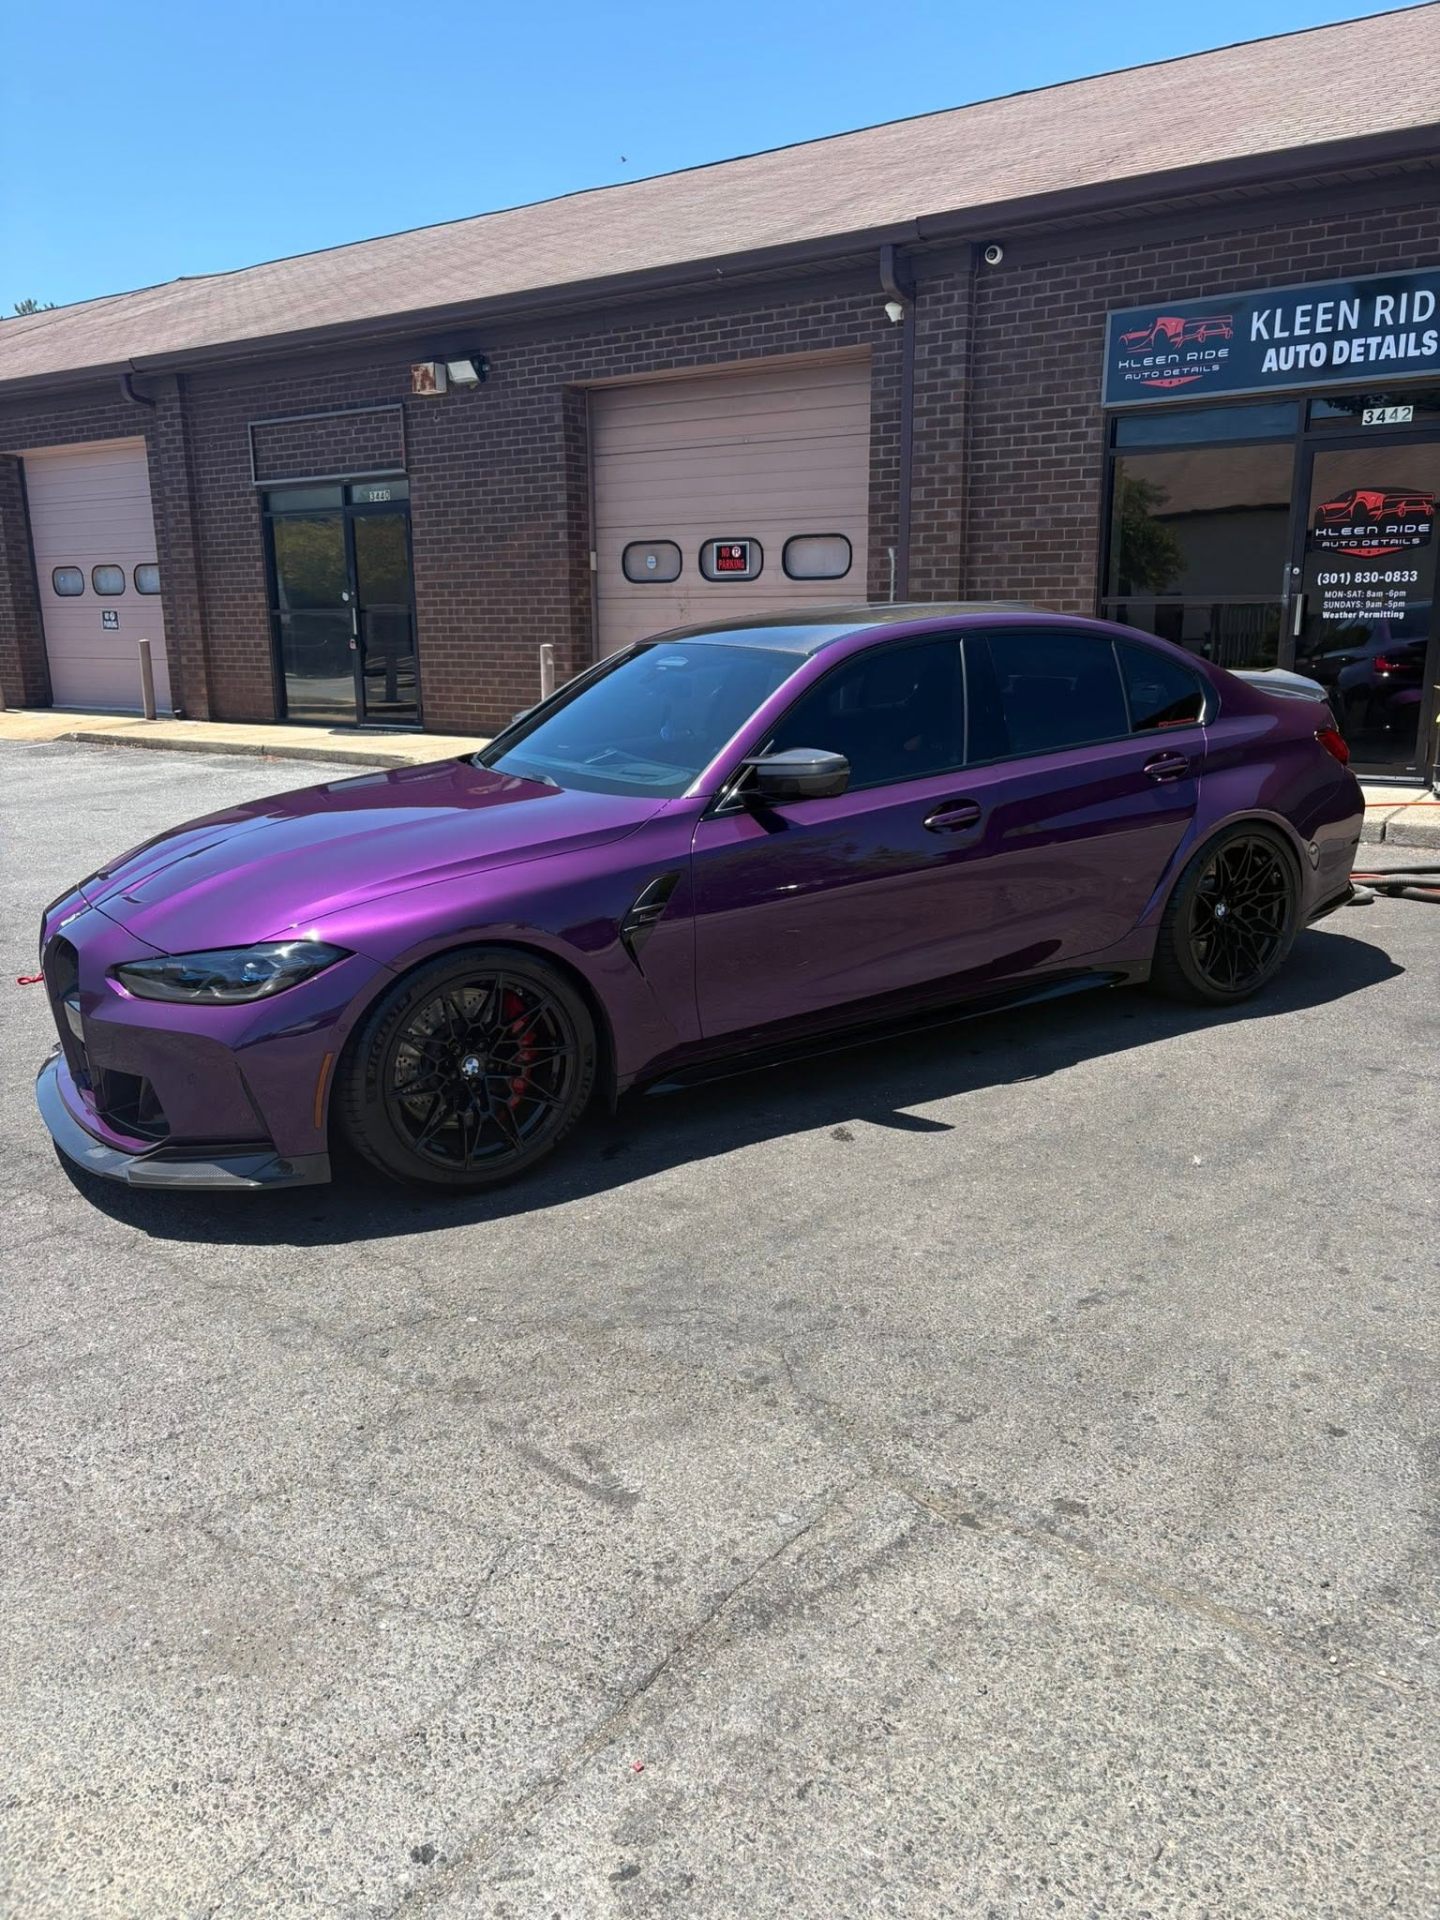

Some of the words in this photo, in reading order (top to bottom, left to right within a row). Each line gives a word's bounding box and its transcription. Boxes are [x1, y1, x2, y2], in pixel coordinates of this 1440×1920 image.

[1250, 298, 1360, 342] KLEEN
[1118, 354, 1180, 369] KLEEN
[1186, 348, 1230, 362] RIDE
[1261, 342, 1328, 373] AUTO
[1332, 330, 1439, 365] DETAILS
[1124, 370, 1160, 381] AUTO
[1163, 364, 1220, 377] DETAILS
[1364, 406, 1412, 424] 3442
[1315, 526, 1378, 537] KLEEN
[1385, 523, 1431, 534] RIDE
[1321, 540, 1358, 548] AUTO
[1361, 537, 1421, 546] DETAILS
[721, 547, 730, 557] NO
[718, 558, 745, 570] PARKING
[1317, 573, 1351, 586] (301)
[1354, 571, 1419, 584] 830-0833
[1324, 590, 1365, 598] MON-SAT:
[1323, 600, 1364, 609] SUNDAYS:
[1365, 600, 1382, 608] 9am
[1322, 611, 1357, 619] Weather
[1358, 610, 1405, 620] Permitting
